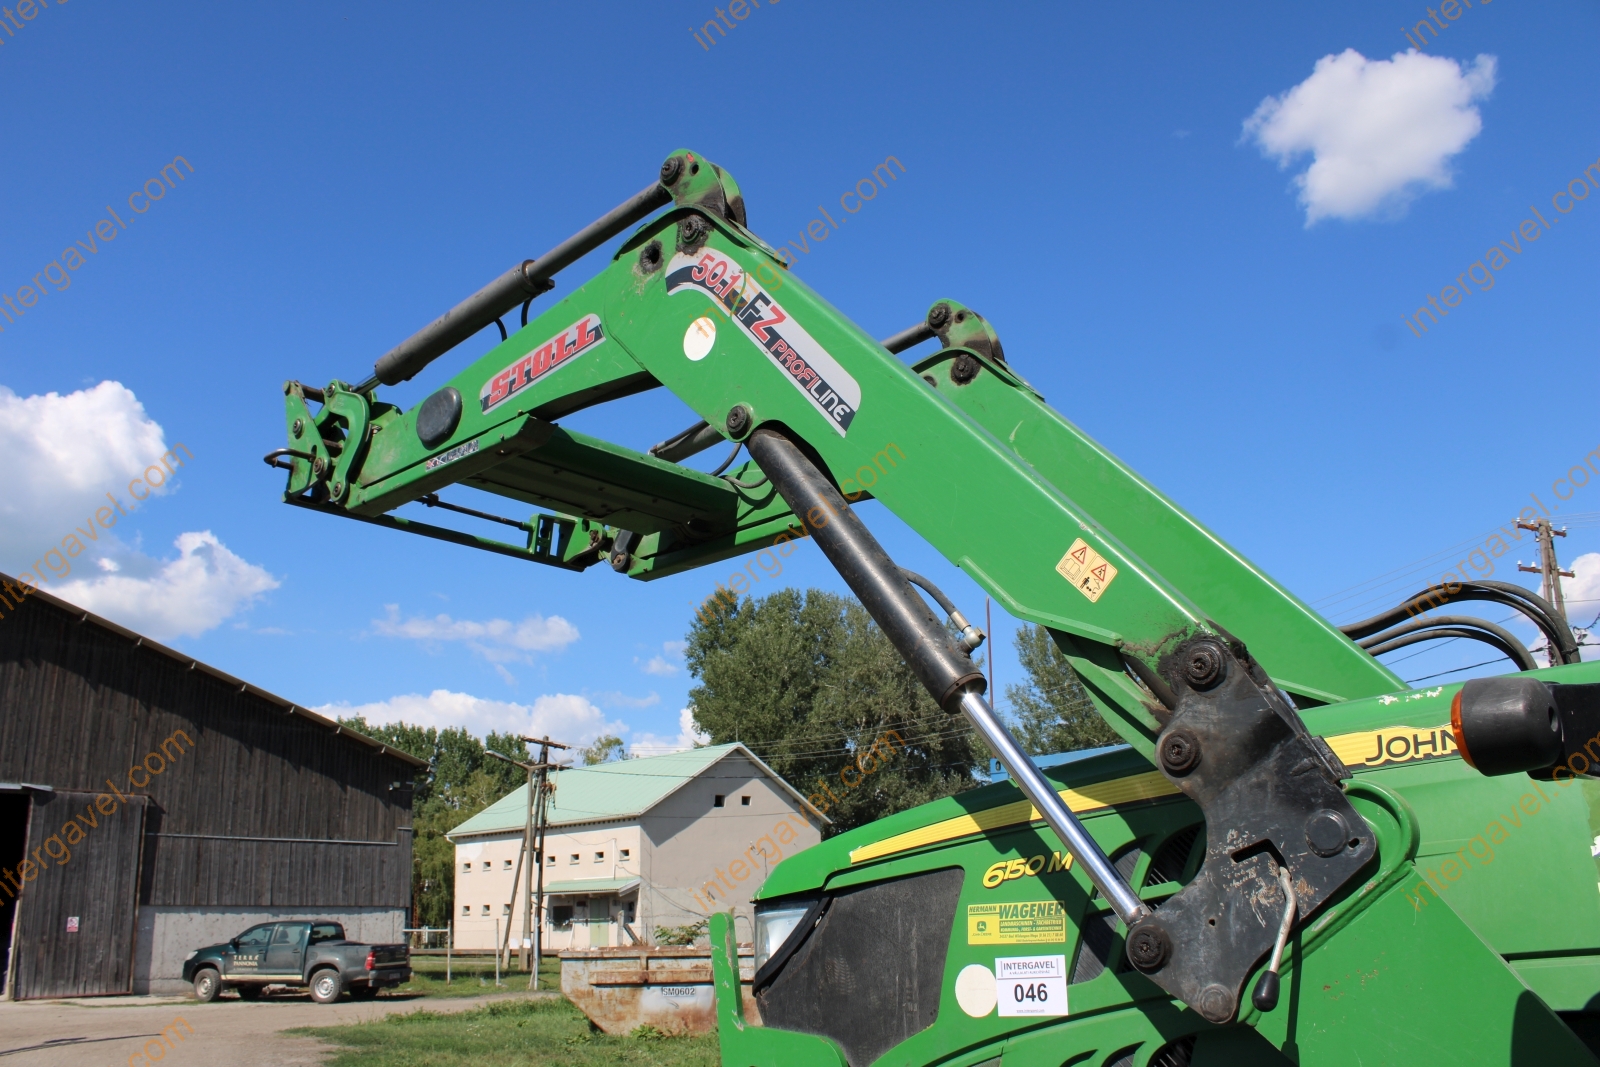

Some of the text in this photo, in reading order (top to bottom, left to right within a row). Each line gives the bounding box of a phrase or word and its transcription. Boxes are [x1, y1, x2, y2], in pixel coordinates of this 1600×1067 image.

[691, 253, 741, 298] 50.1
[737, 291, 787, 344] FZ
[488, 317, 596, 406] STOLL
[968, 902, 1064, 919] HERMANN WAGENER
[1003, 960, 1056, 971] INTERGAVEL
[662, 987, 696, 996] SM0602
[1014, 983, 1048, 1003] 046
